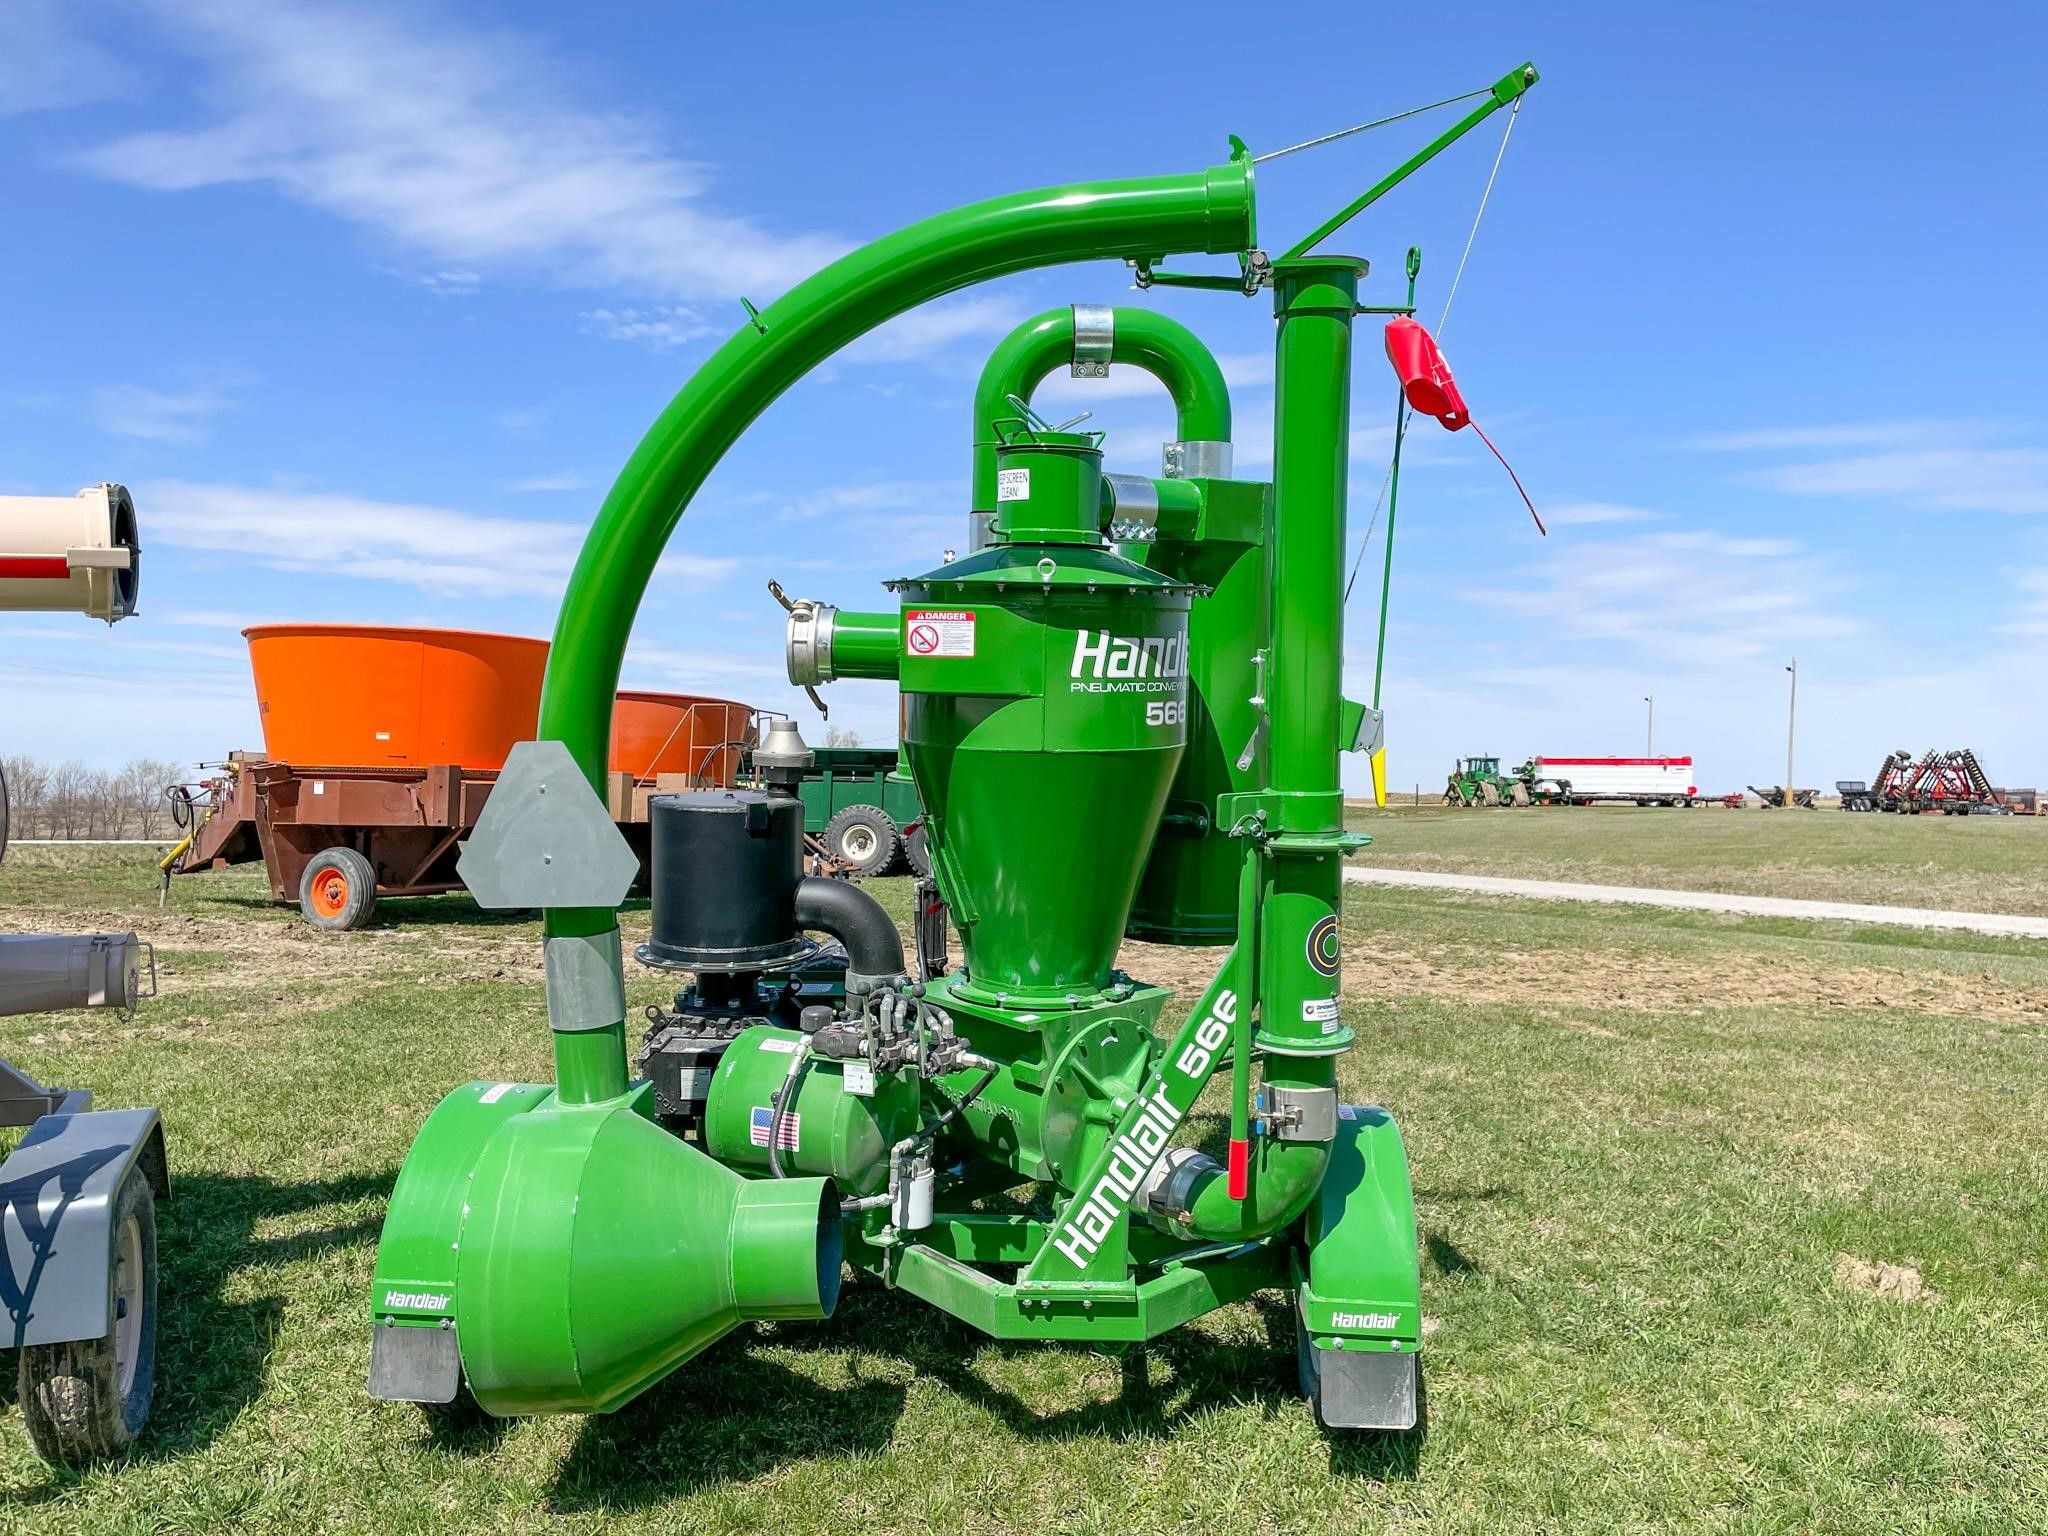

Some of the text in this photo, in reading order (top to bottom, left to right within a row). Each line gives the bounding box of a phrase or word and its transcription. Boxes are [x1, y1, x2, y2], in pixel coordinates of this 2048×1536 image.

[1006, 471, 1028, 484] SCREEN
[924, 612, 967, 621] DANGER
[1071, 682, 1146, 693] PNEUMATIC
[1053, 989, 1236, 1270] Handlair 566
[384, 1290, 451, 1310] Handlair
[1331, 1311, 1401, 1329] Handlair
